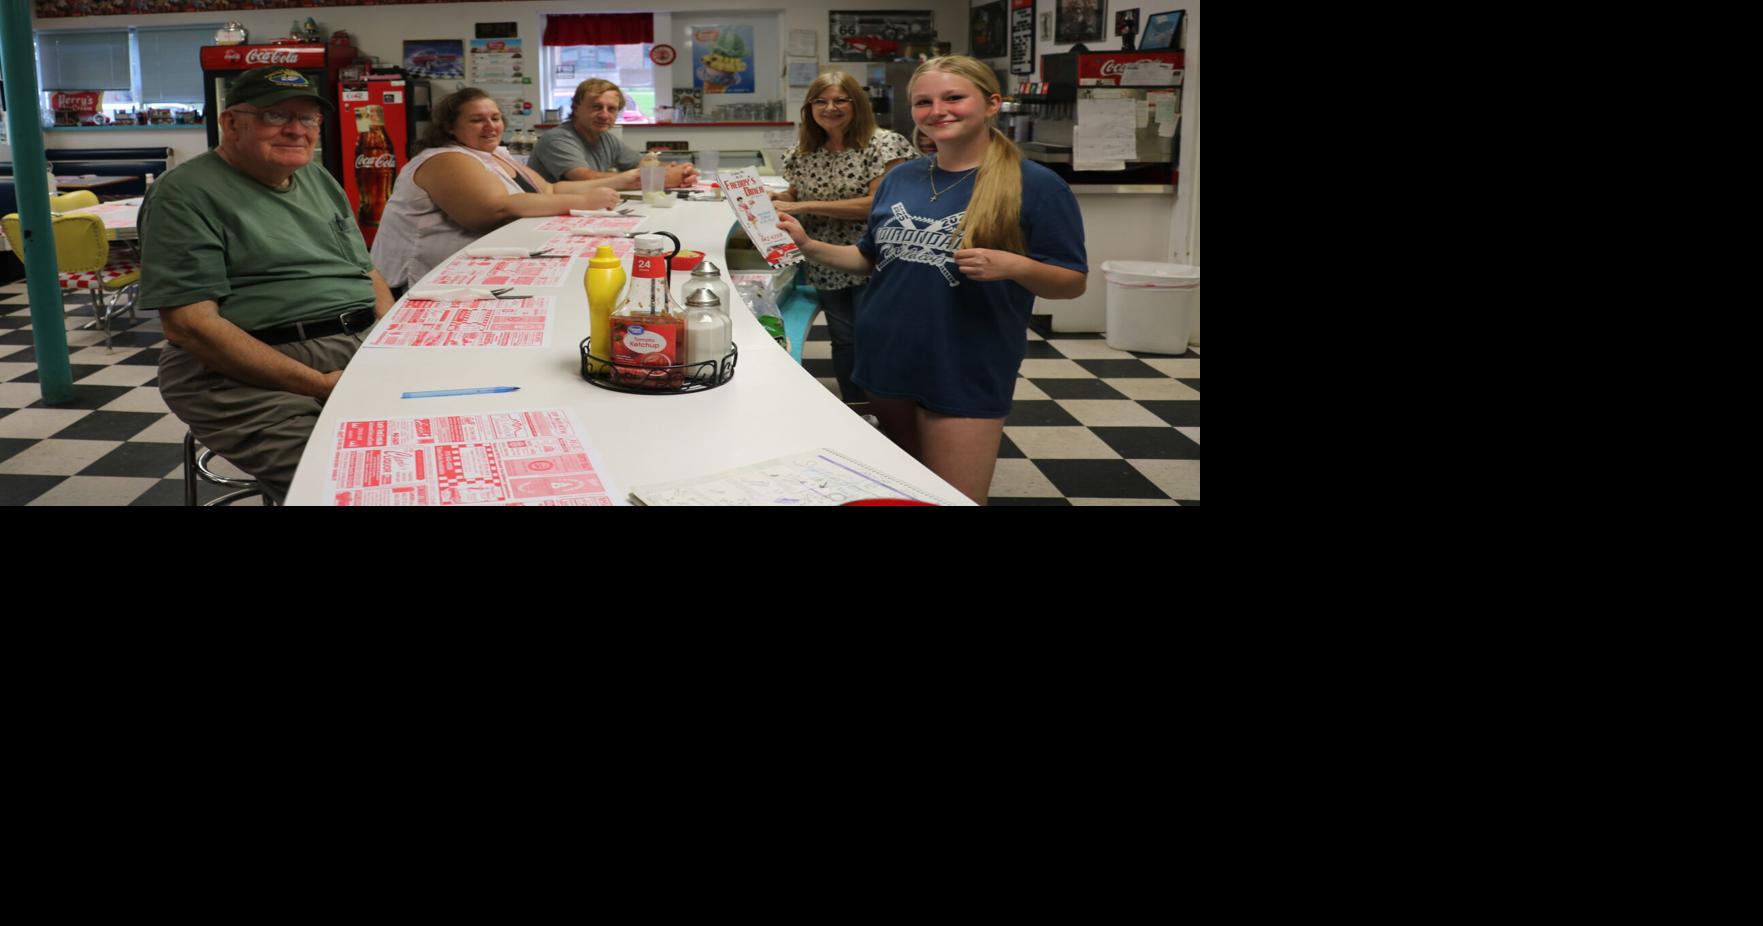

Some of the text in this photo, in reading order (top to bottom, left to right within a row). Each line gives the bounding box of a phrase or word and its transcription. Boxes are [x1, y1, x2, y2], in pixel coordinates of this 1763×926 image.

[839, 25, 856, 36] 66
[245, 49, 298, 64] Coca-Cola
[638, 260, 651, 268] 24
[629, 341, 660, 350] Ketchup
